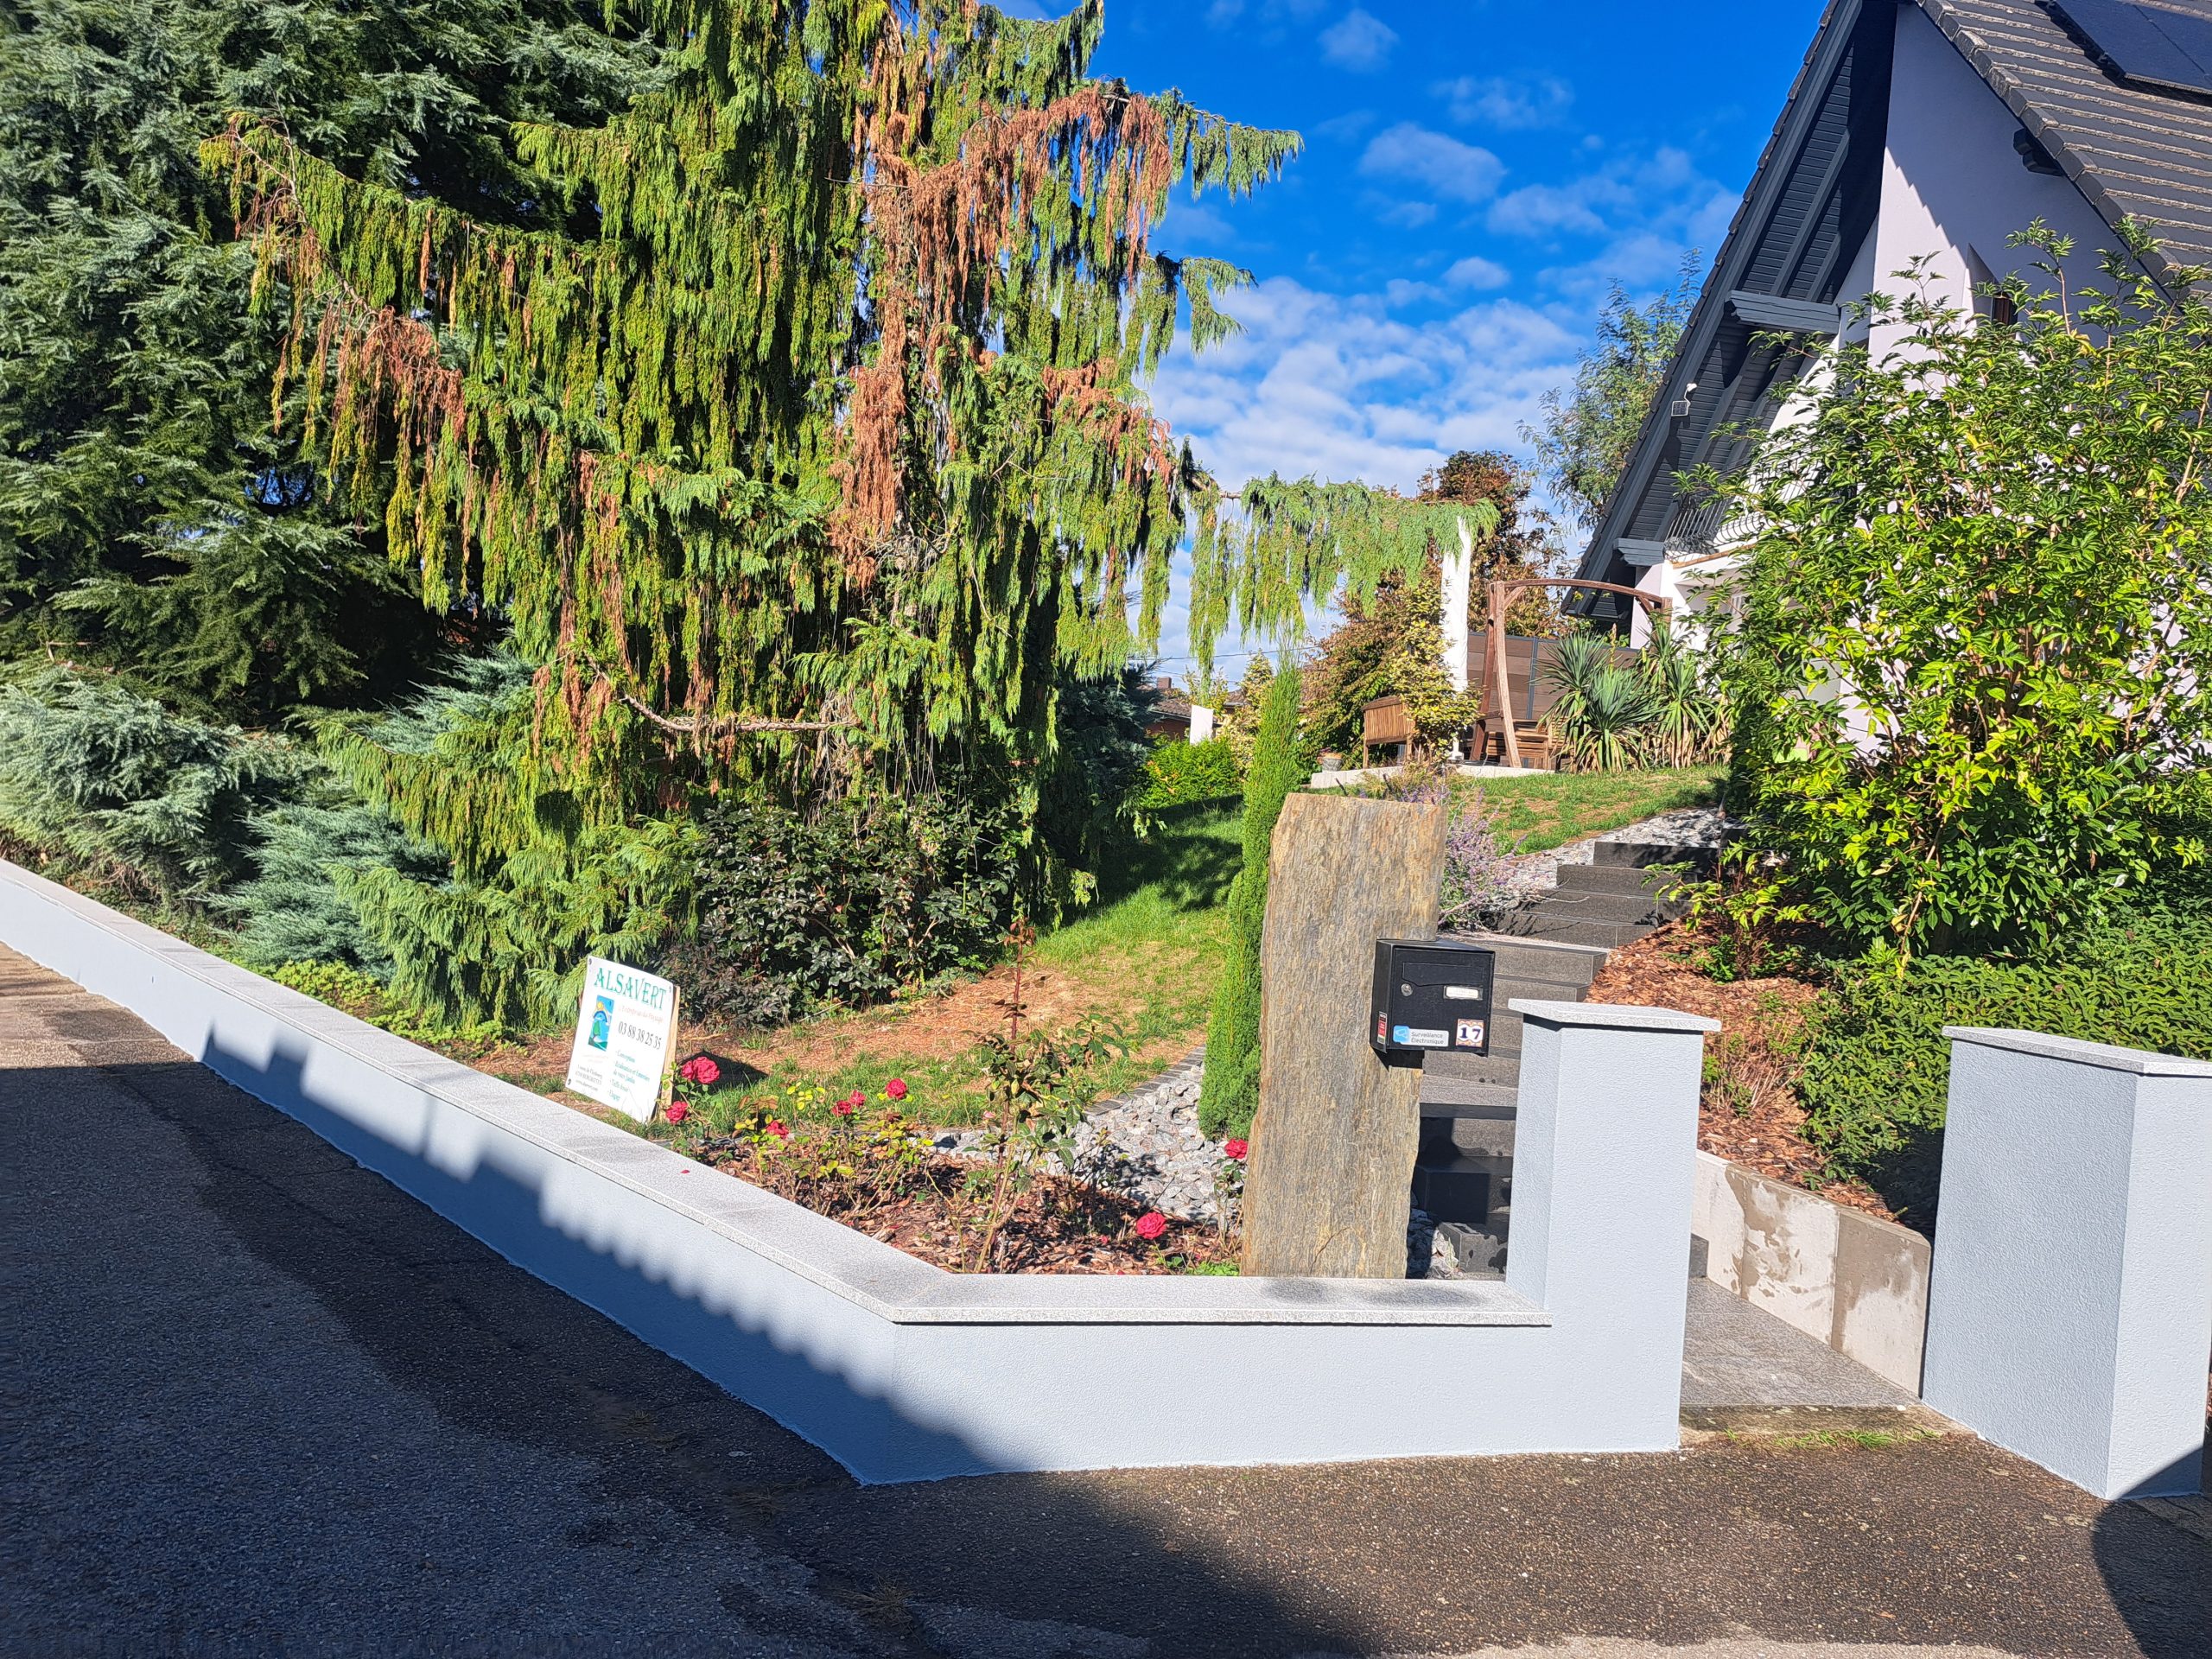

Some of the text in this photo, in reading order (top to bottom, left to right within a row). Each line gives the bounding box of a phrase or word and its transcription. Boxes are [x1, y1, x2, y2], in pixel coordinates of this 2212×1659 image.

[594, 967, 667, 1010] ALSAVERT
[618, 1020, 662, 1050] 03 88 38 25 35
[1459, 1027, 1481, 1039] 17
